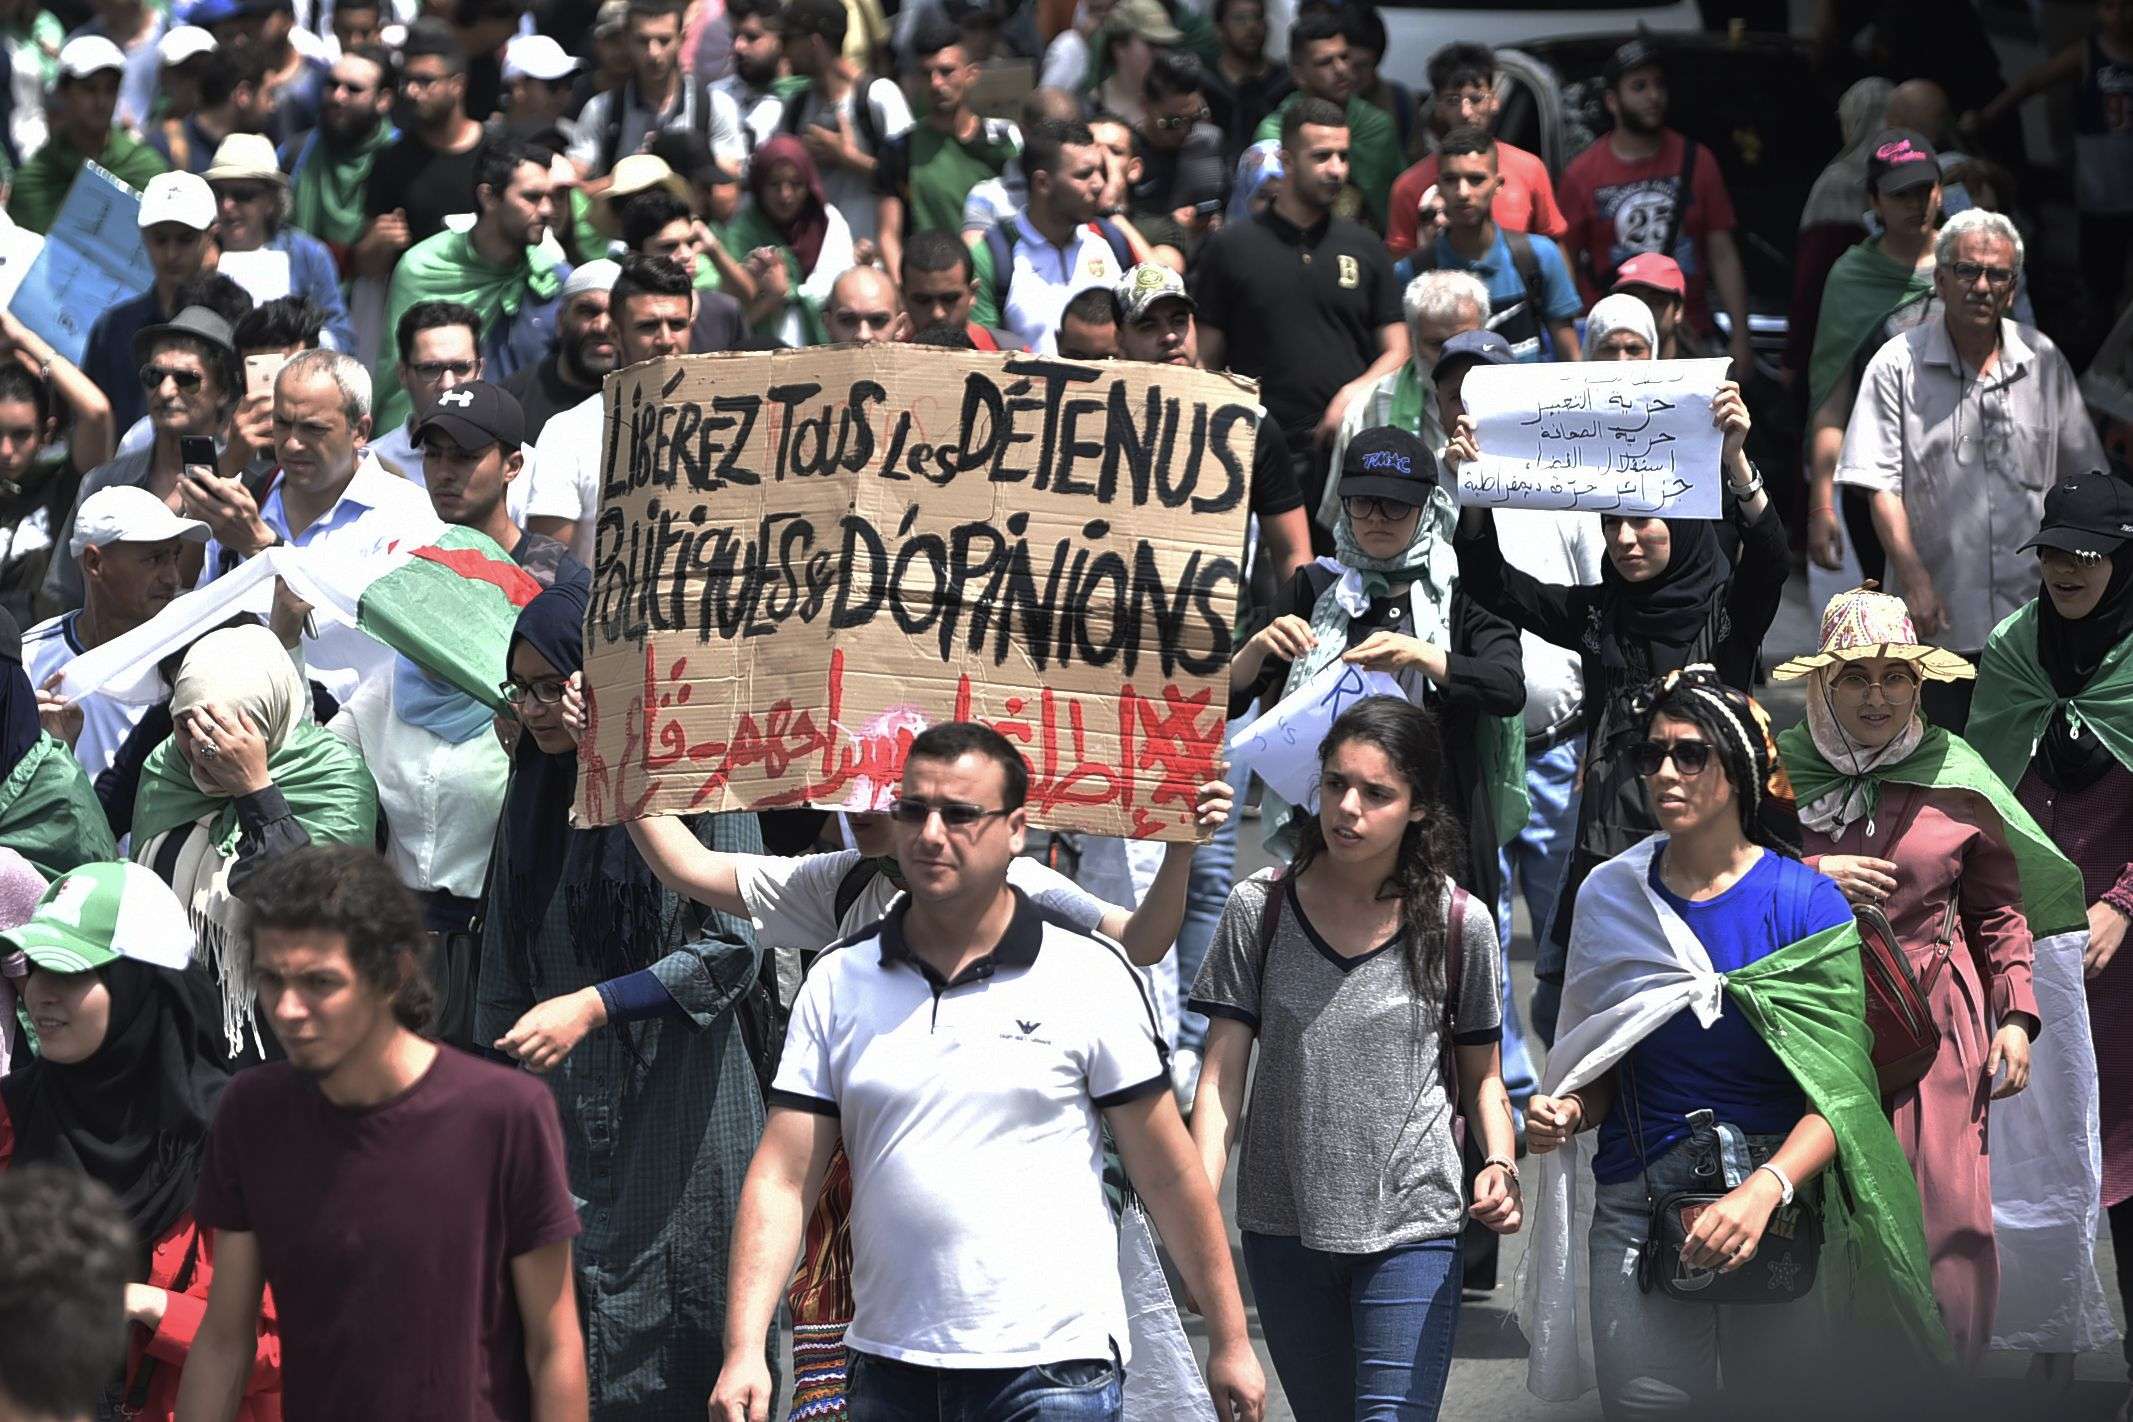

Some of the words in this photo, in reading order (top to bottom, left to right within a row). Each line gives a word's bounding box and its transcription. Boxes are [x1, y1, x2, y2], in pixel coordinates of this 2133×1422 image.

[1521, 387, 1592, 426] التعبير
[1608, 390, 1676, 432] حرية
[957, 359, 1258, 514] DÉTENUS
[1540, 420, 1603, 441] الصحافة
[1614, 430, 1677, 458] حرية
[1597, 446, 1676, 476] استقلال
